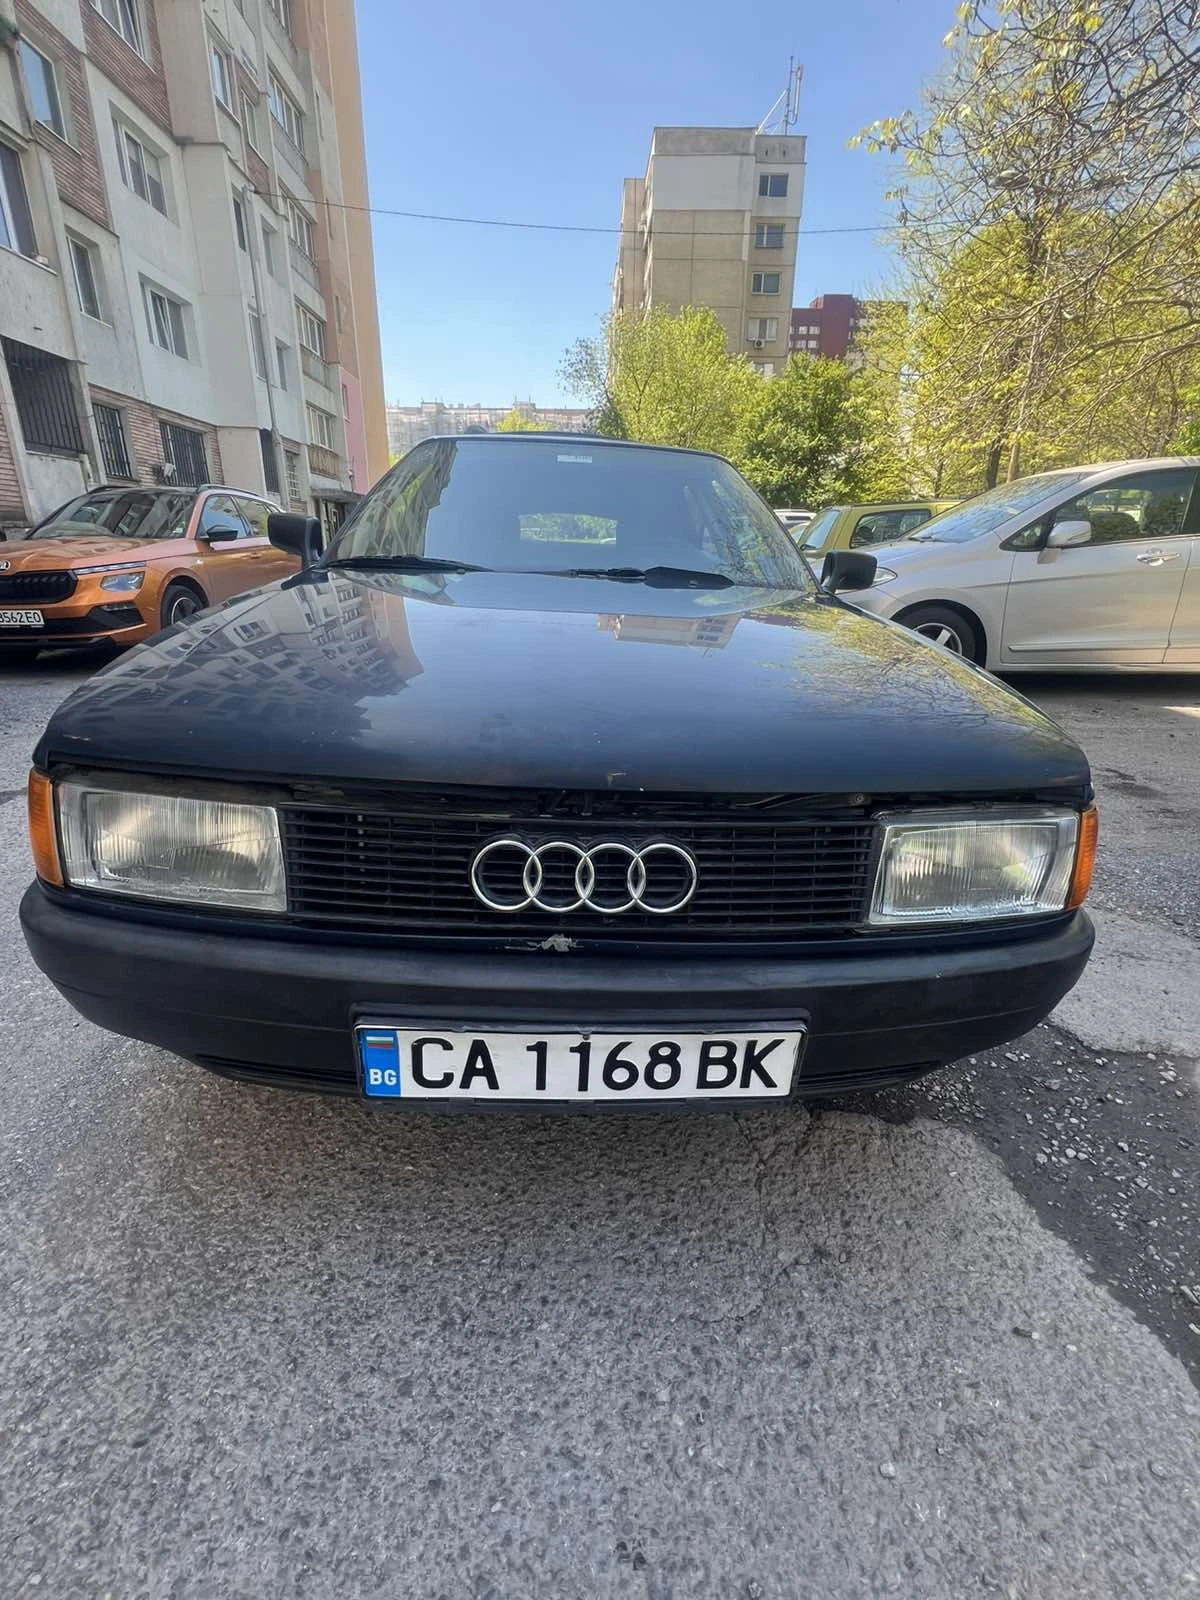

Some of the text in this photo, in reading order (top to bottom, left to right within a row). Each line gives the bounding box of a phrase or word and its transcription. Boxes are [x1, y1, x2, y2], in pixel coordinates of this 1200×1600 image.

[369, 1068, 398, 1086] BG
[411, 1037, 786, 1092] CA 1168 BK
